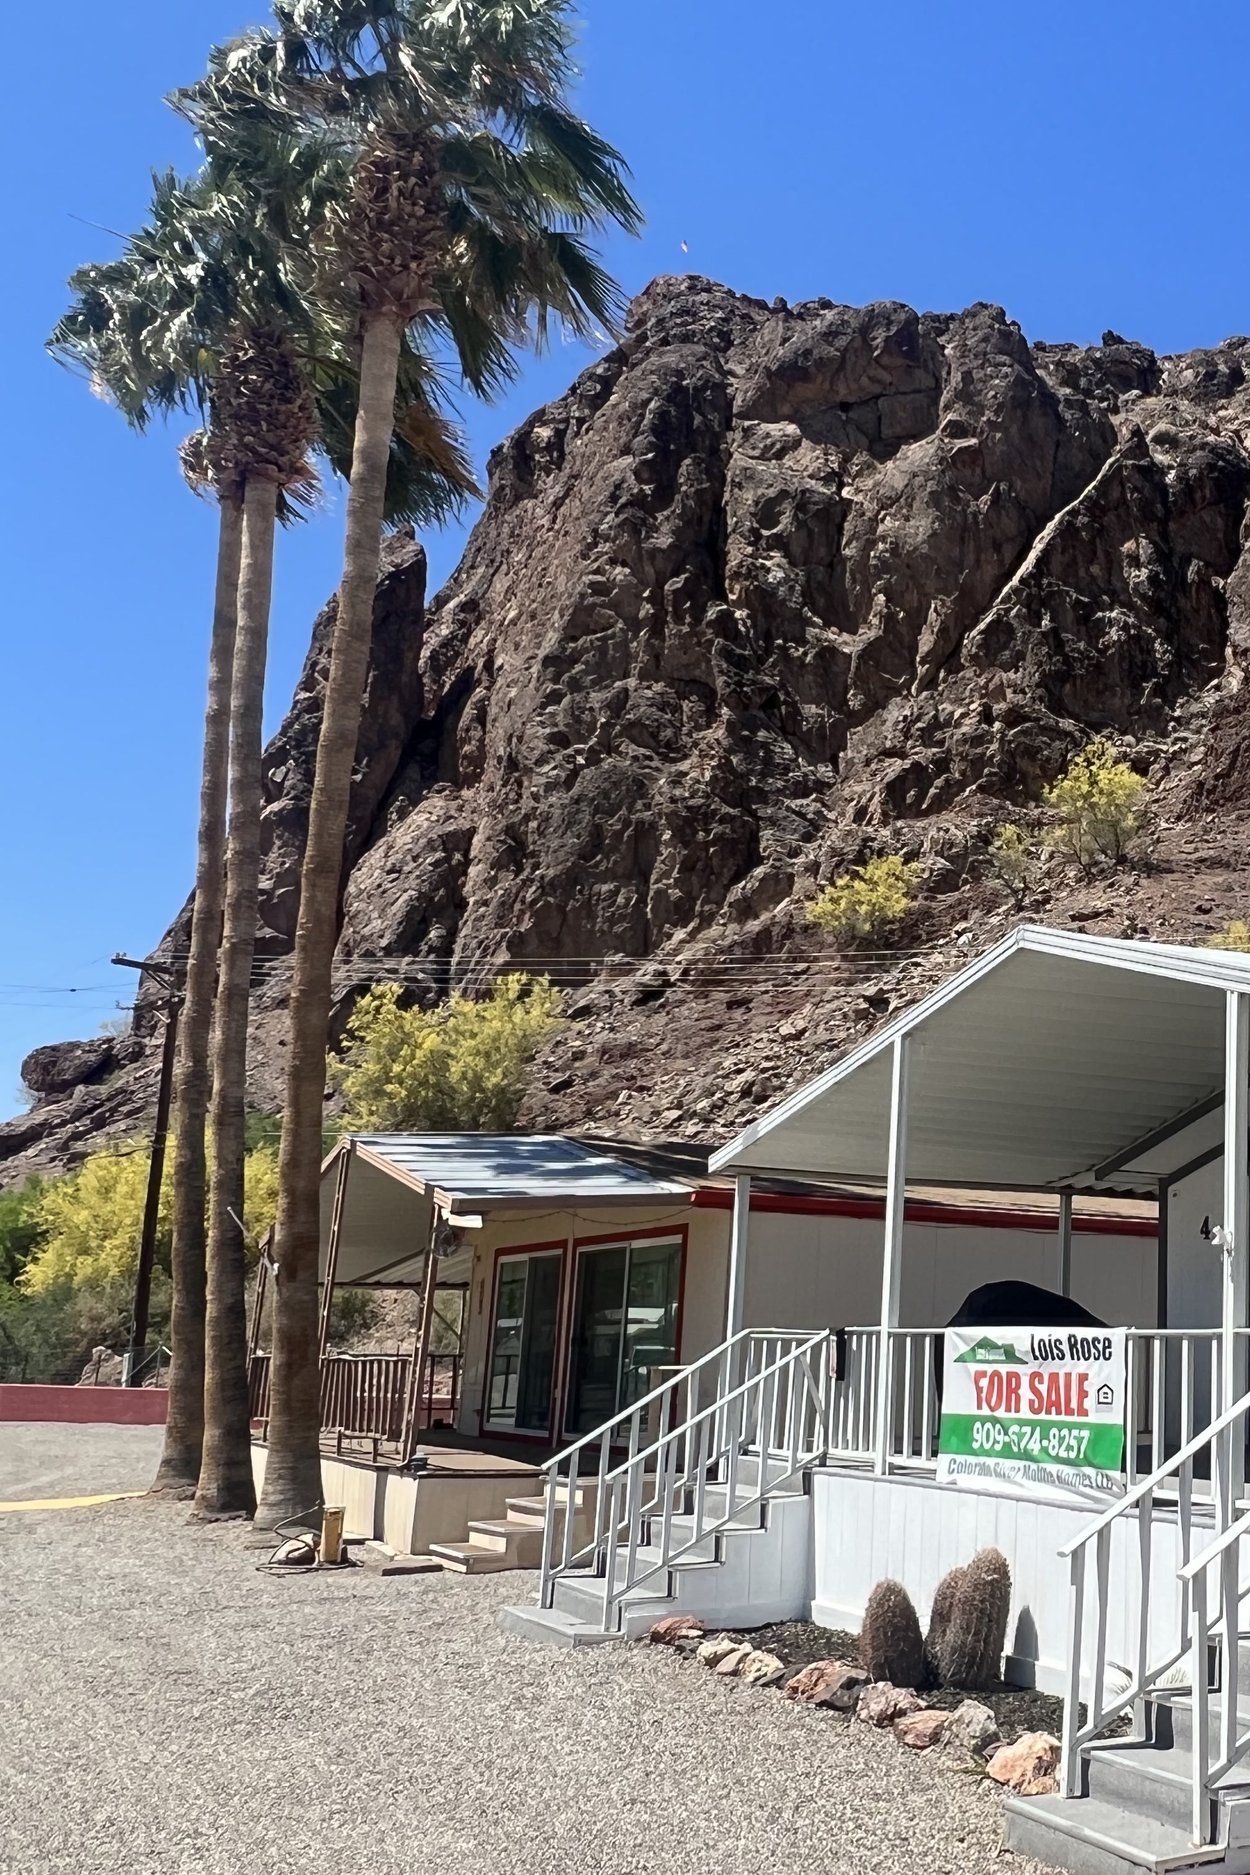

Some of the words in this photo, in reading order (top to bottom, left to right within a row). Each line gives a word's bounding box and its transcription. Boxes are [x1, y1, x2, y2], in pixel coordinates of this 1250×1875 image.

[1030, 1333, 1066, 1362] Lois
[1067, 1334, 1113, 1362] Rose
[974, 1369, 1021, 1413] FOR
[1028, 1371, 1089, 1417] SALE
